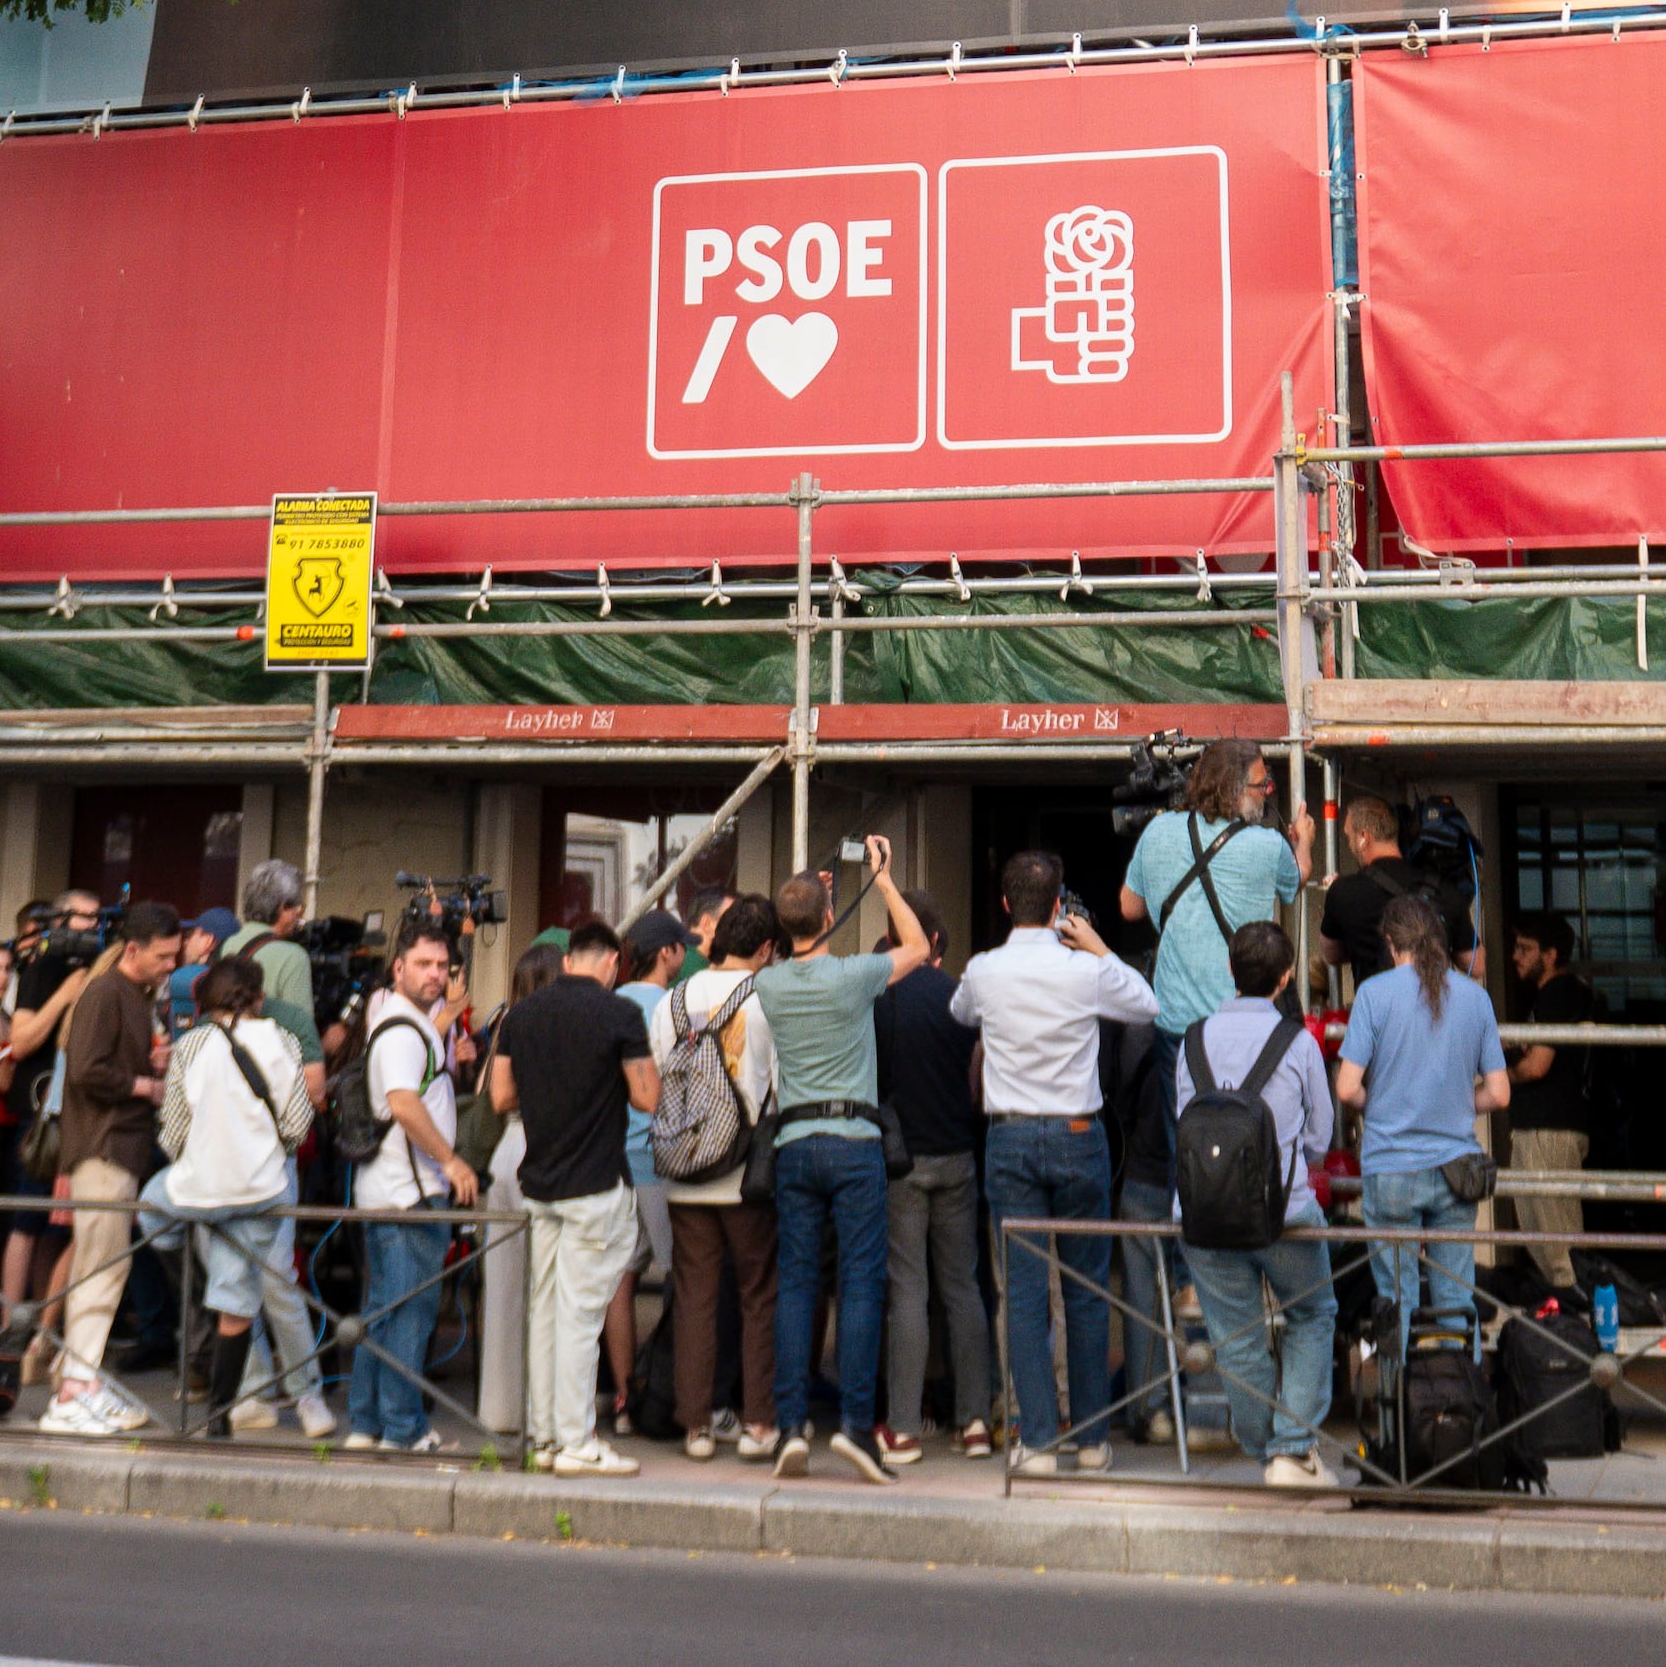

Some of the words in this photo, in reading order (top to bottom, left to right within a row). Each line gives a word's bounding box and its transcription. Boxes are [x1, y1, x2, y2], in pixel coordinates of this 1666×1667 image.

[684, 220, 892, 305] PSOE
[276, 500, 315, 512] ALARMA
[316, 499, 370, 511] CONECTADA
[290, 539, 304, 550] 91
[309, 538, 365, 550] 7853880
[282, 625, 352, 638] CENTAURO
[505, 709, 583, 731] Layher
[1001, 709, 1084, 731] Layher
